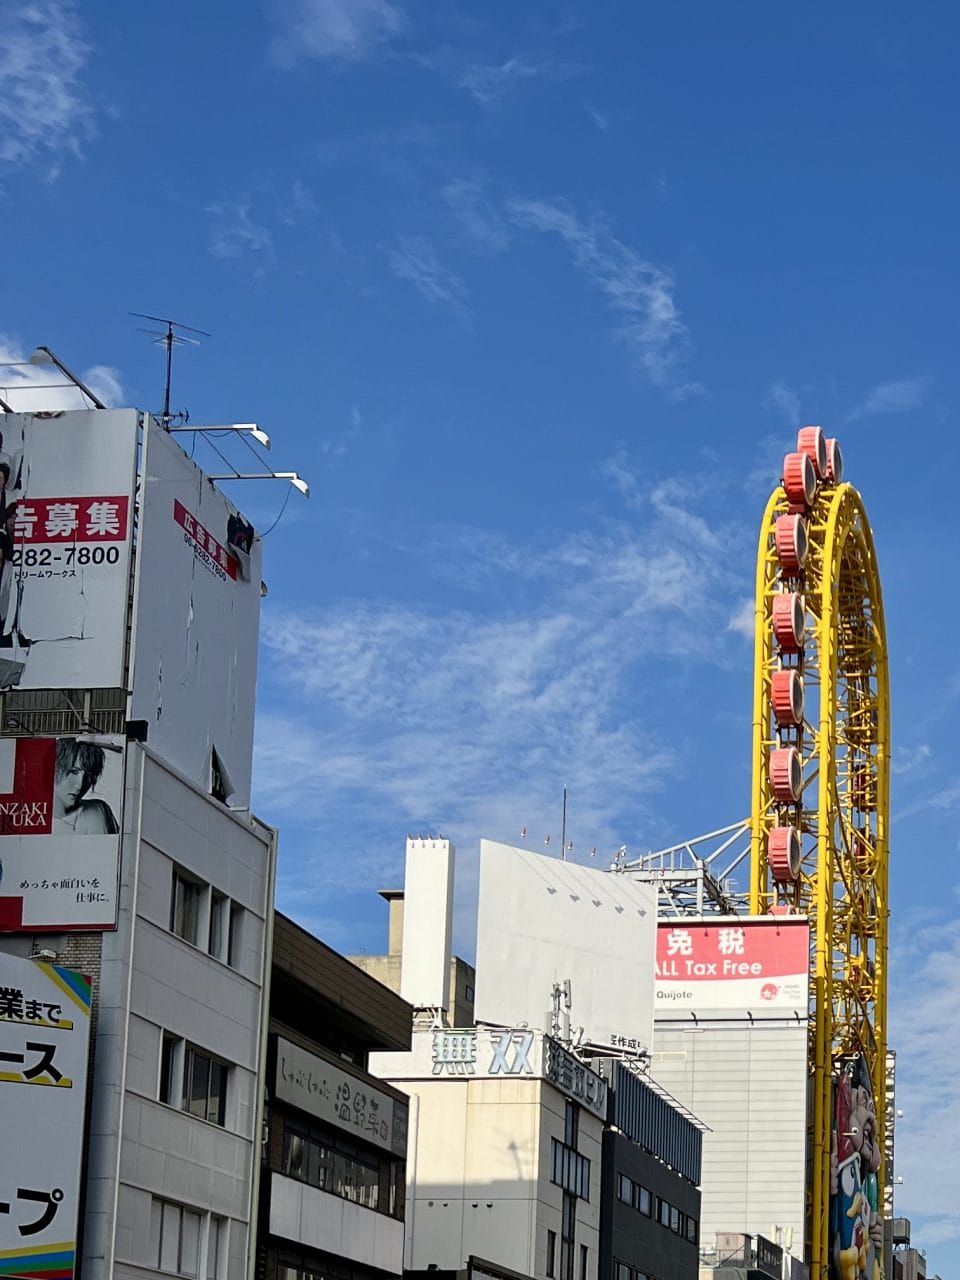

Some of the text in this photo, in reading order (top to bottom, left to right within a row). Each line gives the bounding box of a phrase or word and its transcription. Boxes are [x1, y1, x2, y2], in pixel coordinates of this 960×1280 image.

[667, 928, 744, 955] 免税
[685, 960, 717, 975] Tax
[723, 960, 762, 975] Free
[656, 991, 693, 1000] Quijote
